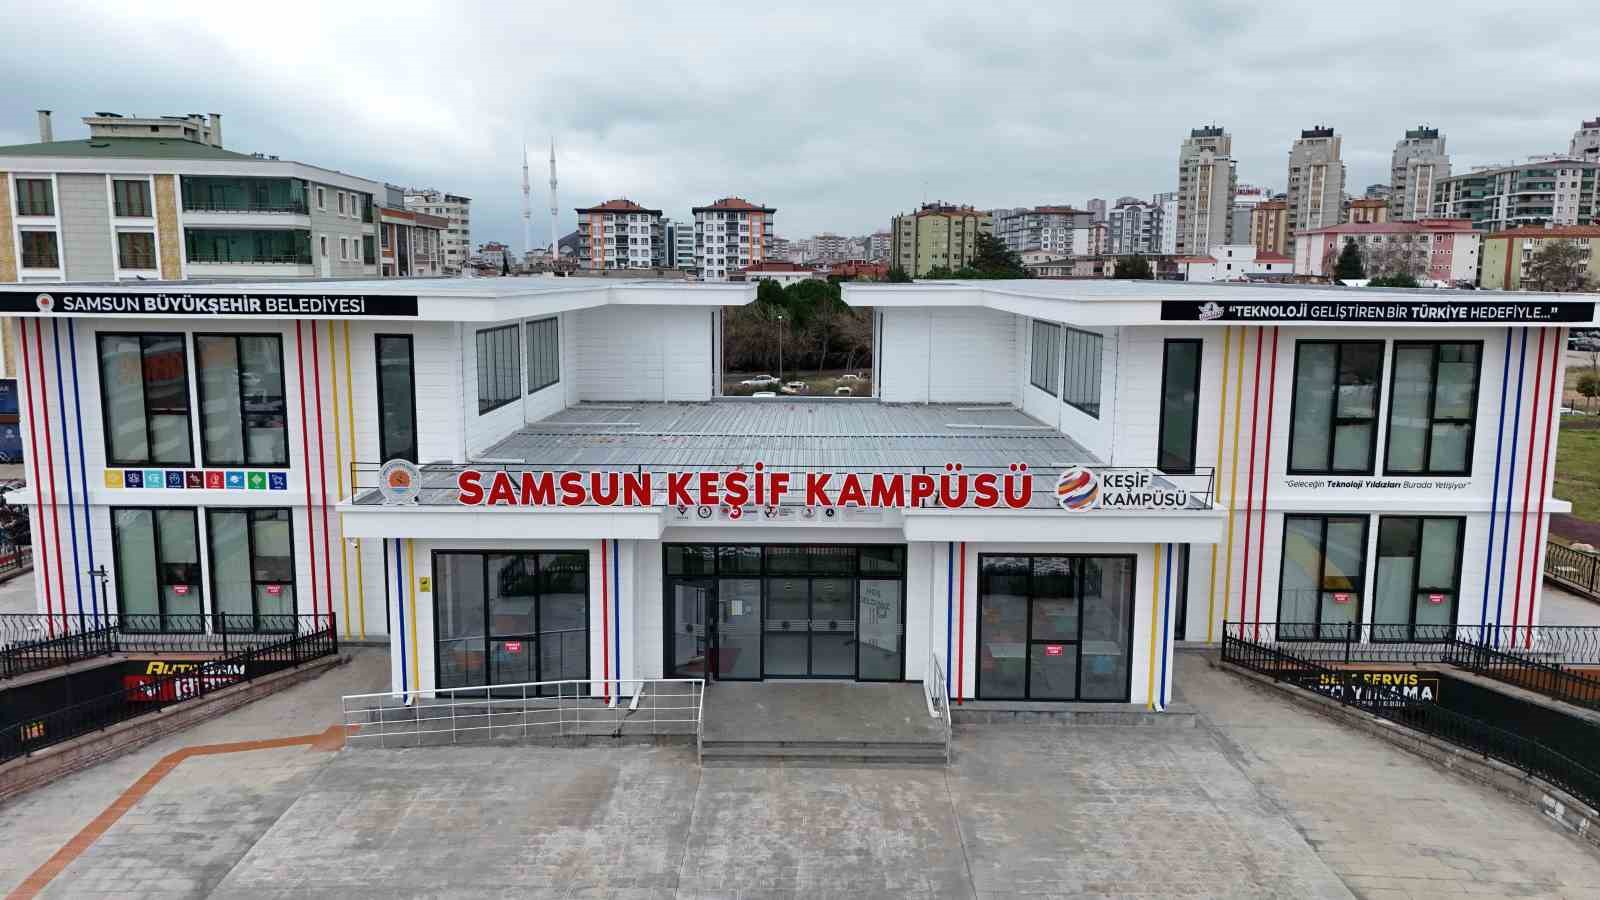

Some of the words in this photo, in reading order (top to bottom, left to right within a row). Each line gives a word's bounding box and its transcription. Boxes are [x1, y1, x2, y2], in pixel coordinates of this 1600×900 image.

[63, 296, 140, 312] SAMSUN
[144, 294, 262, 315] BÜYÜKŞEHİR
[265, 295, 366, 313] BELEDİYESİ
[1310, 303, 1386, 320] GELİŞTİREN
[1387, 304, 1408, 318] BİR
[1411, 304, 1468, 318] TÜRKİYE
[457, 471, 652, 507] SAMSUN
[666, 461, 790, 519] KEŞİF
[805, 462, 1034, 509] KAMPÜSÜ
[1103, 472, 1149, 492] KEŞİF
[1327, 480, 1363, 490] Teknoloji
[1402, 480, 1432, 489] Burada
[1102, 490, 1187, 506] KAMPÜSÜ
